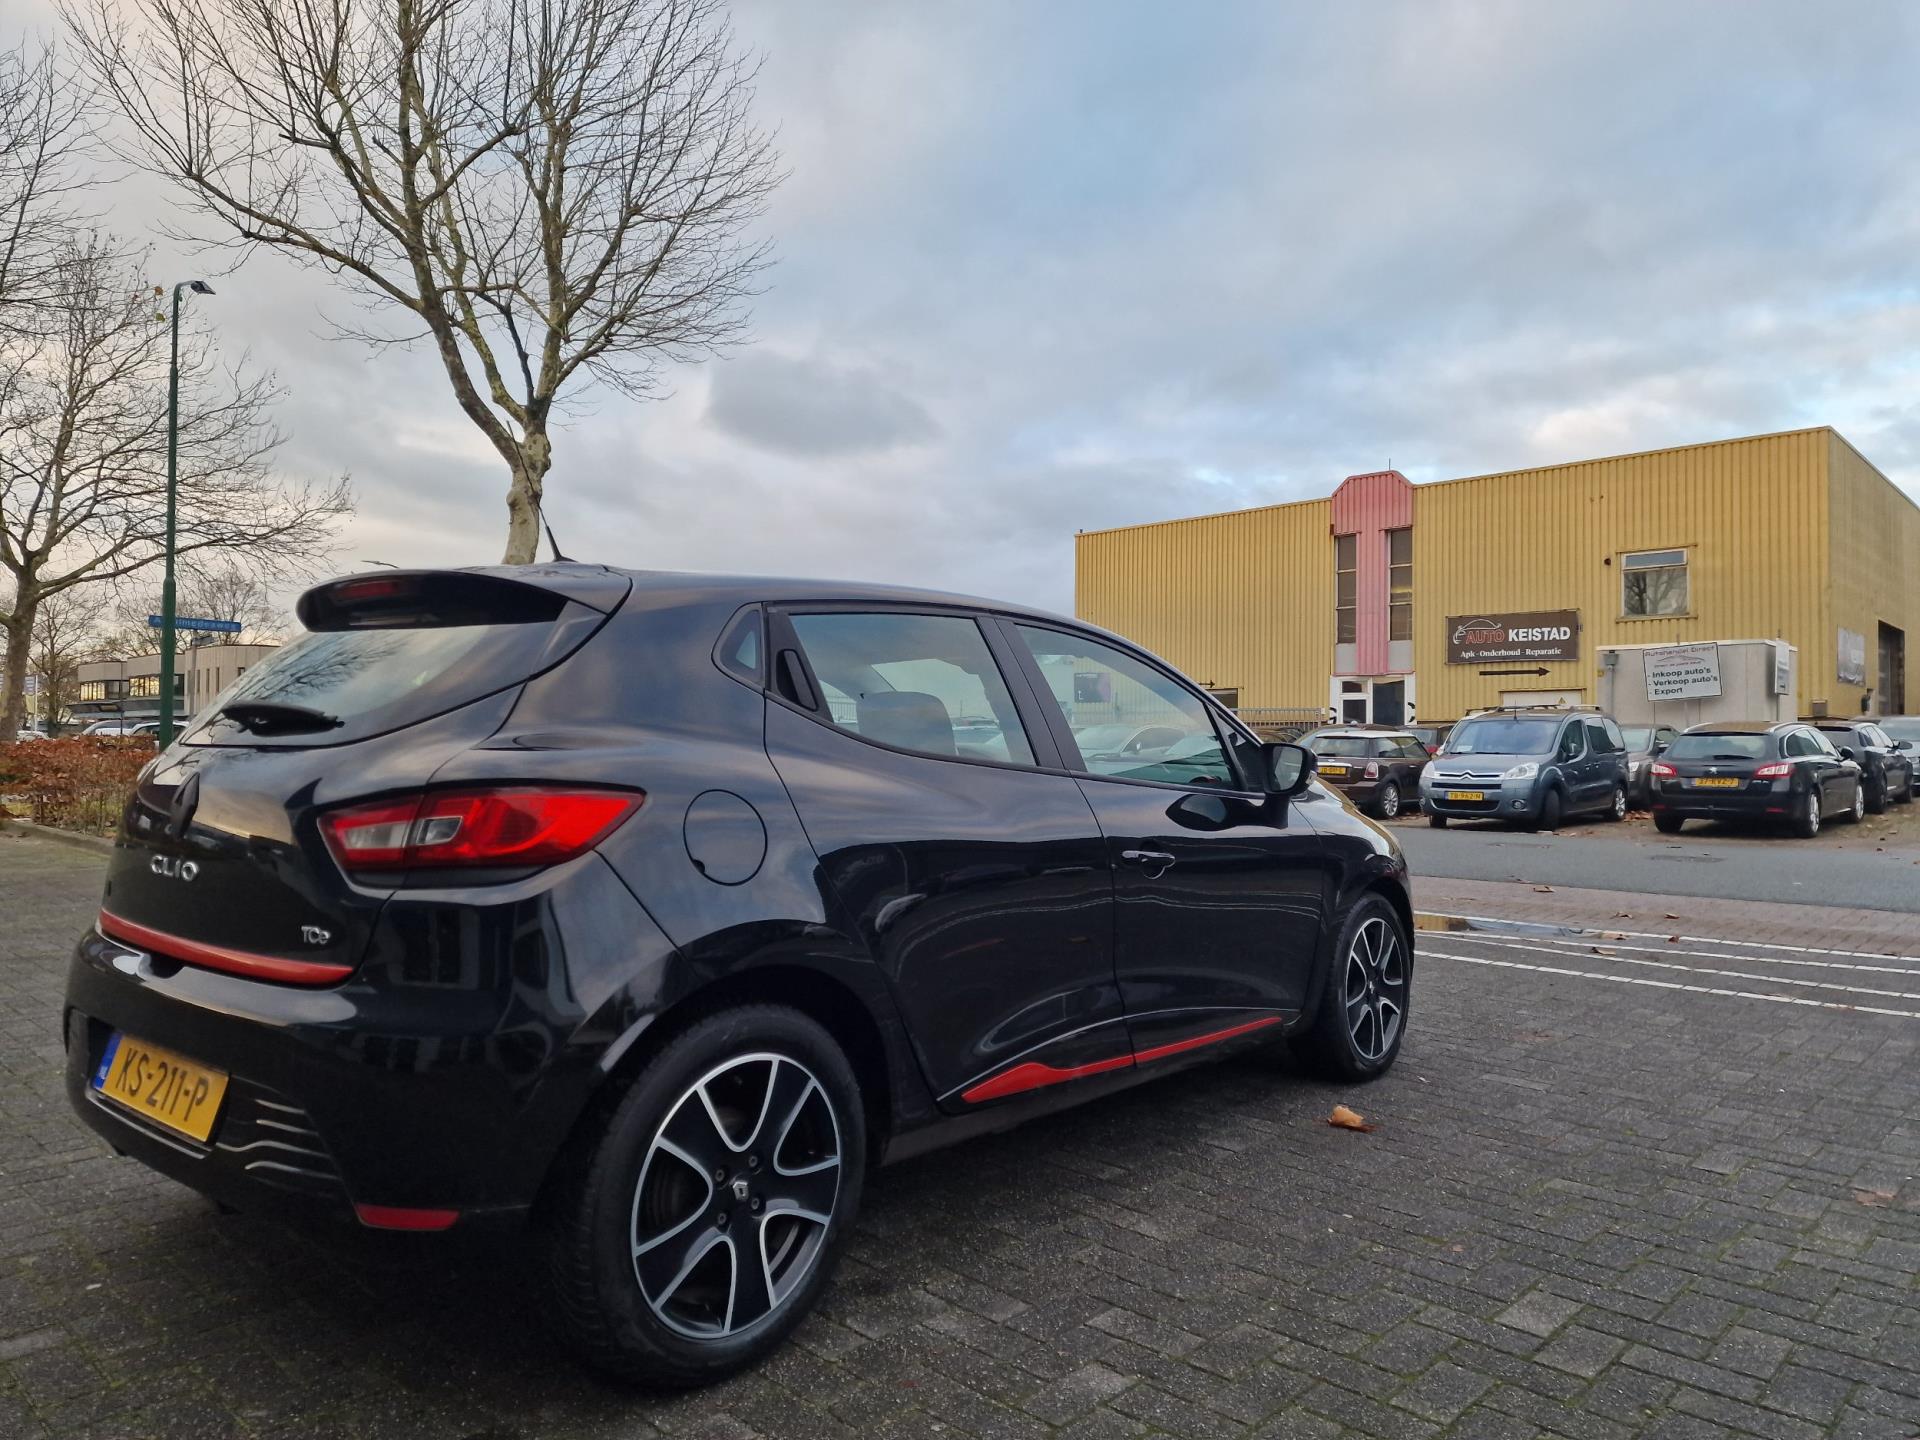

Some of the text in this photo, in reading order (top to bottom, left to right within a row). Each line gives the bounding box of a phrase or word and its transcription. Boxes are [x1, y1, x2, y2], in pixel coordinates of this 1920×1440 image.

[1465, 627, 1571, 644] AUTO KEISTAD
[1460, 647, 1562, 659] Apk Onderhoud Reparatie
[1652, 667, 1712, 678] Inkoop auto's
[1653, 675, 1719, 686] Verkoop auto's
[1654, 687, 1683, 695] Export
[151, 854, 200, 882] CLIO
[301, 925, 331, 945] TCe
[115, 1048, 209, 1122] KS-211-P
